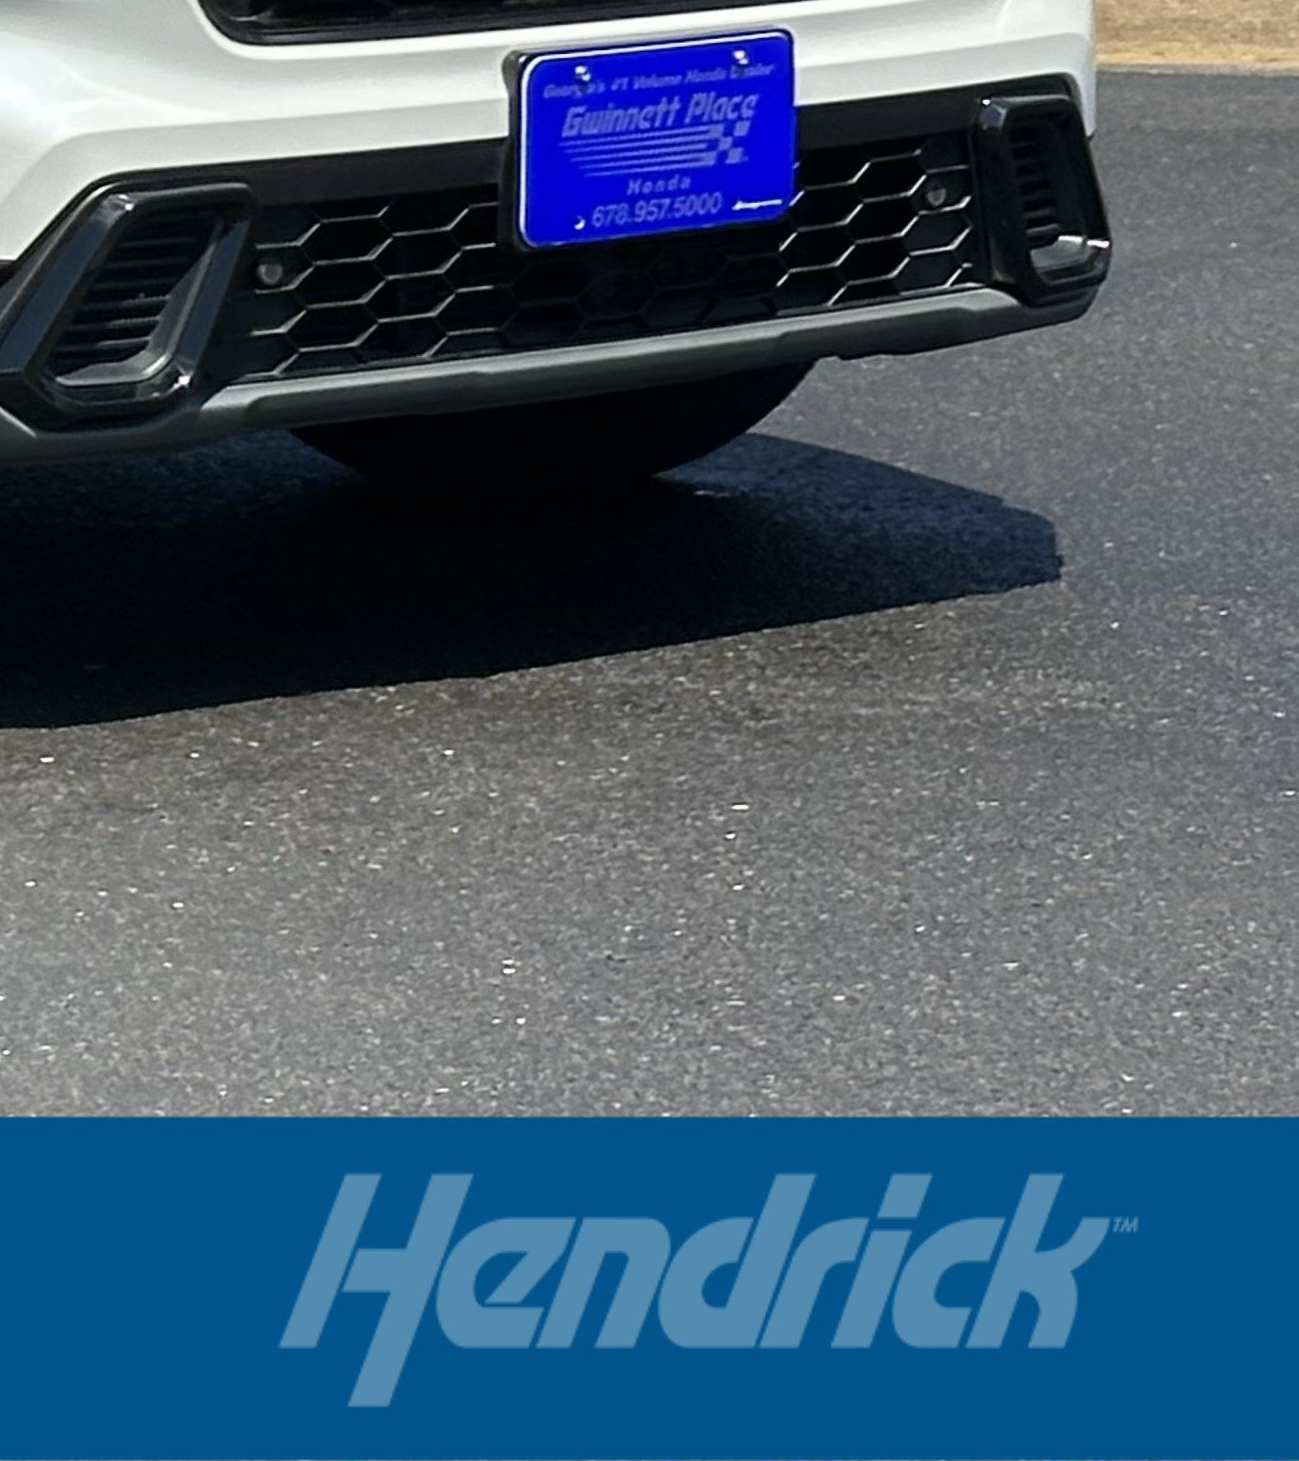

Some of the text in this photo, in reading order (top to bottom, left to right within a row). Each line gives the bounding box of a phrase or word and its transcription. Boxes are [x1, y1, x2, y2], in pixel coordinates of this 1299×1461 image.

[632, 73, 682, 89] Volume
[684, 67, 727, 84] Honda
[562, 91, 759, 137] Gwinnett Place
[626, 174, 692, 196] Honda
[592, 193, 722, 227] 678.957.5000
